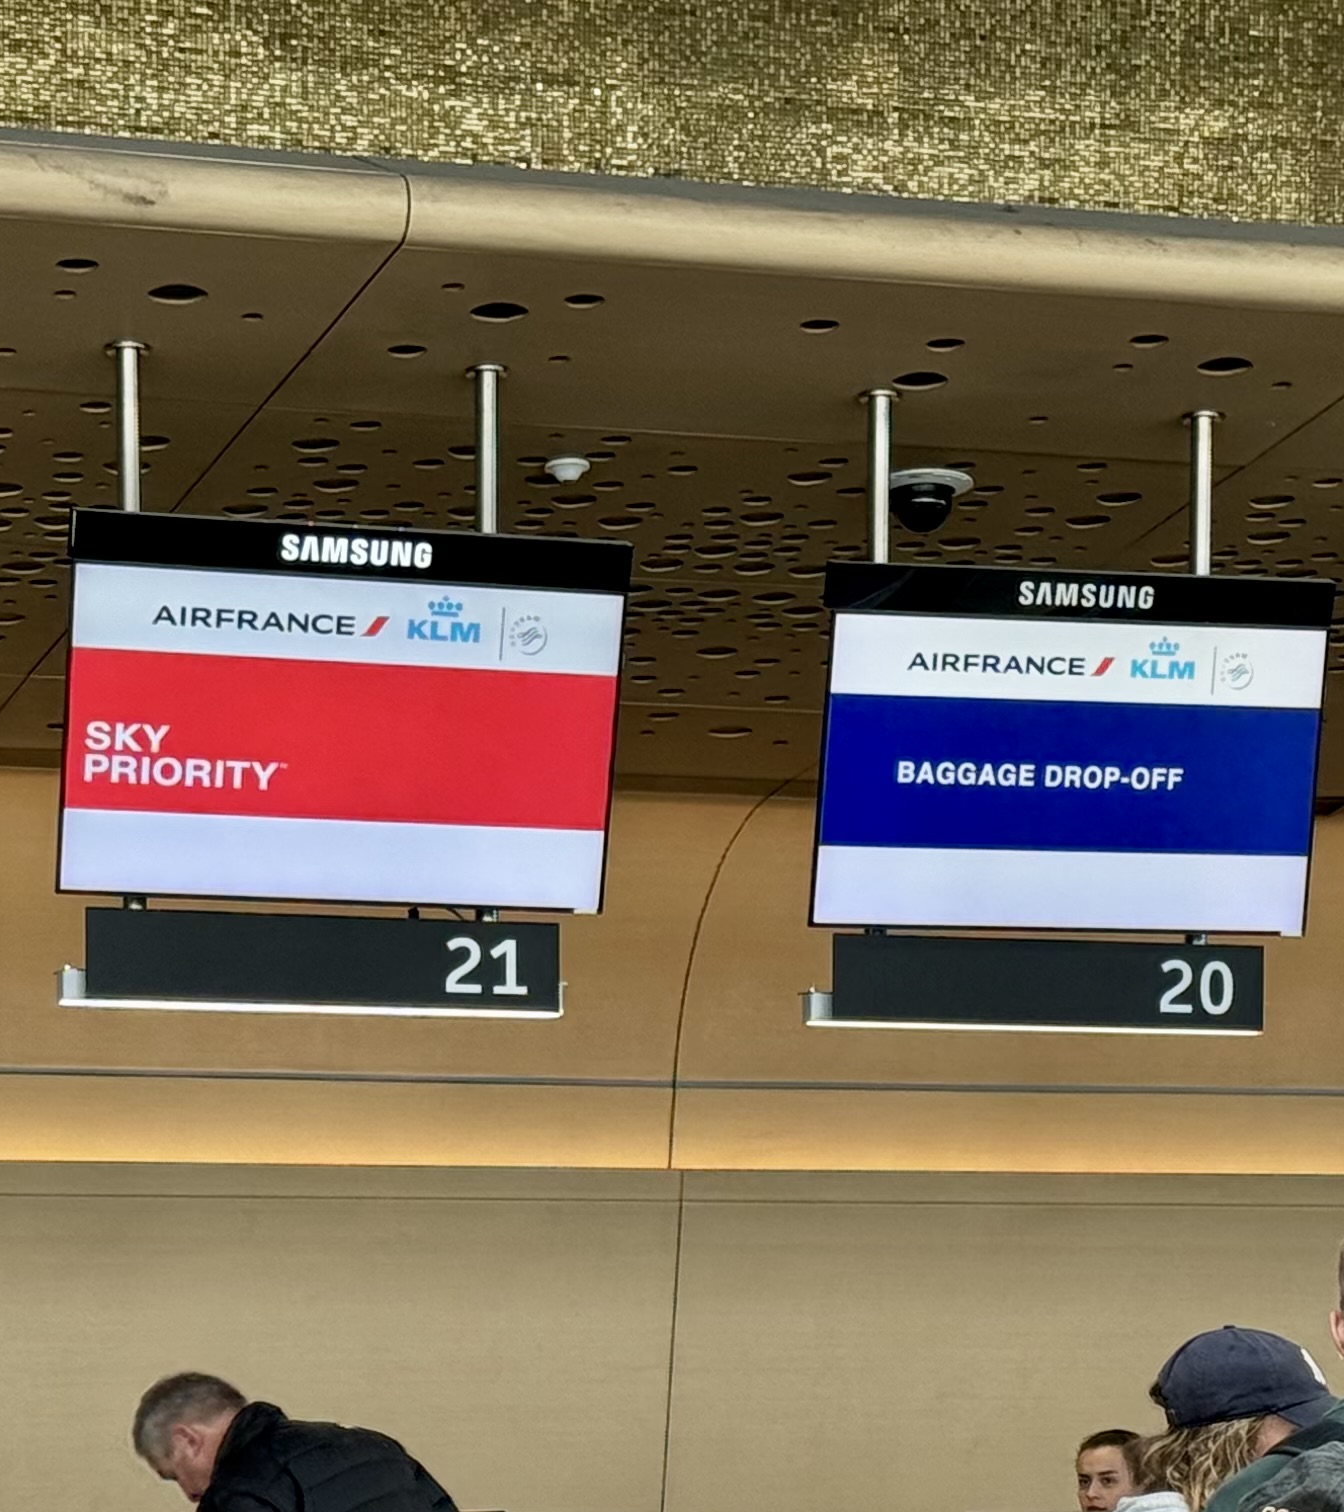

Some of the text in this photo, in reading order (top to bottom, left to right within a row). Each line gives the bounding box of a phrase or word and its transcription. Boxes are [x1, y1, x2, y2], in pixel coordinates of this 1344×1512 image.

[281, 534, 432, 568] SAMSUNG
[1019, 581, 1155, 609] SAMSUNG
[152, 605, 356, 636] AIRFRANCE
[407, 619, 481, 643] KLM
[907, 652, 1086, 677] AIRFRANCE
[1130, 659, 1195, 680] KLM
[85, 722, 170, 753] SKY
[83, 754, 279, 791] PRIORITY
[897, 761, 1183, 791] BAGGAGE DROP-OFF
[445, 937, 529, 995] 21
[1159, 959, 1234, 1015] 20
